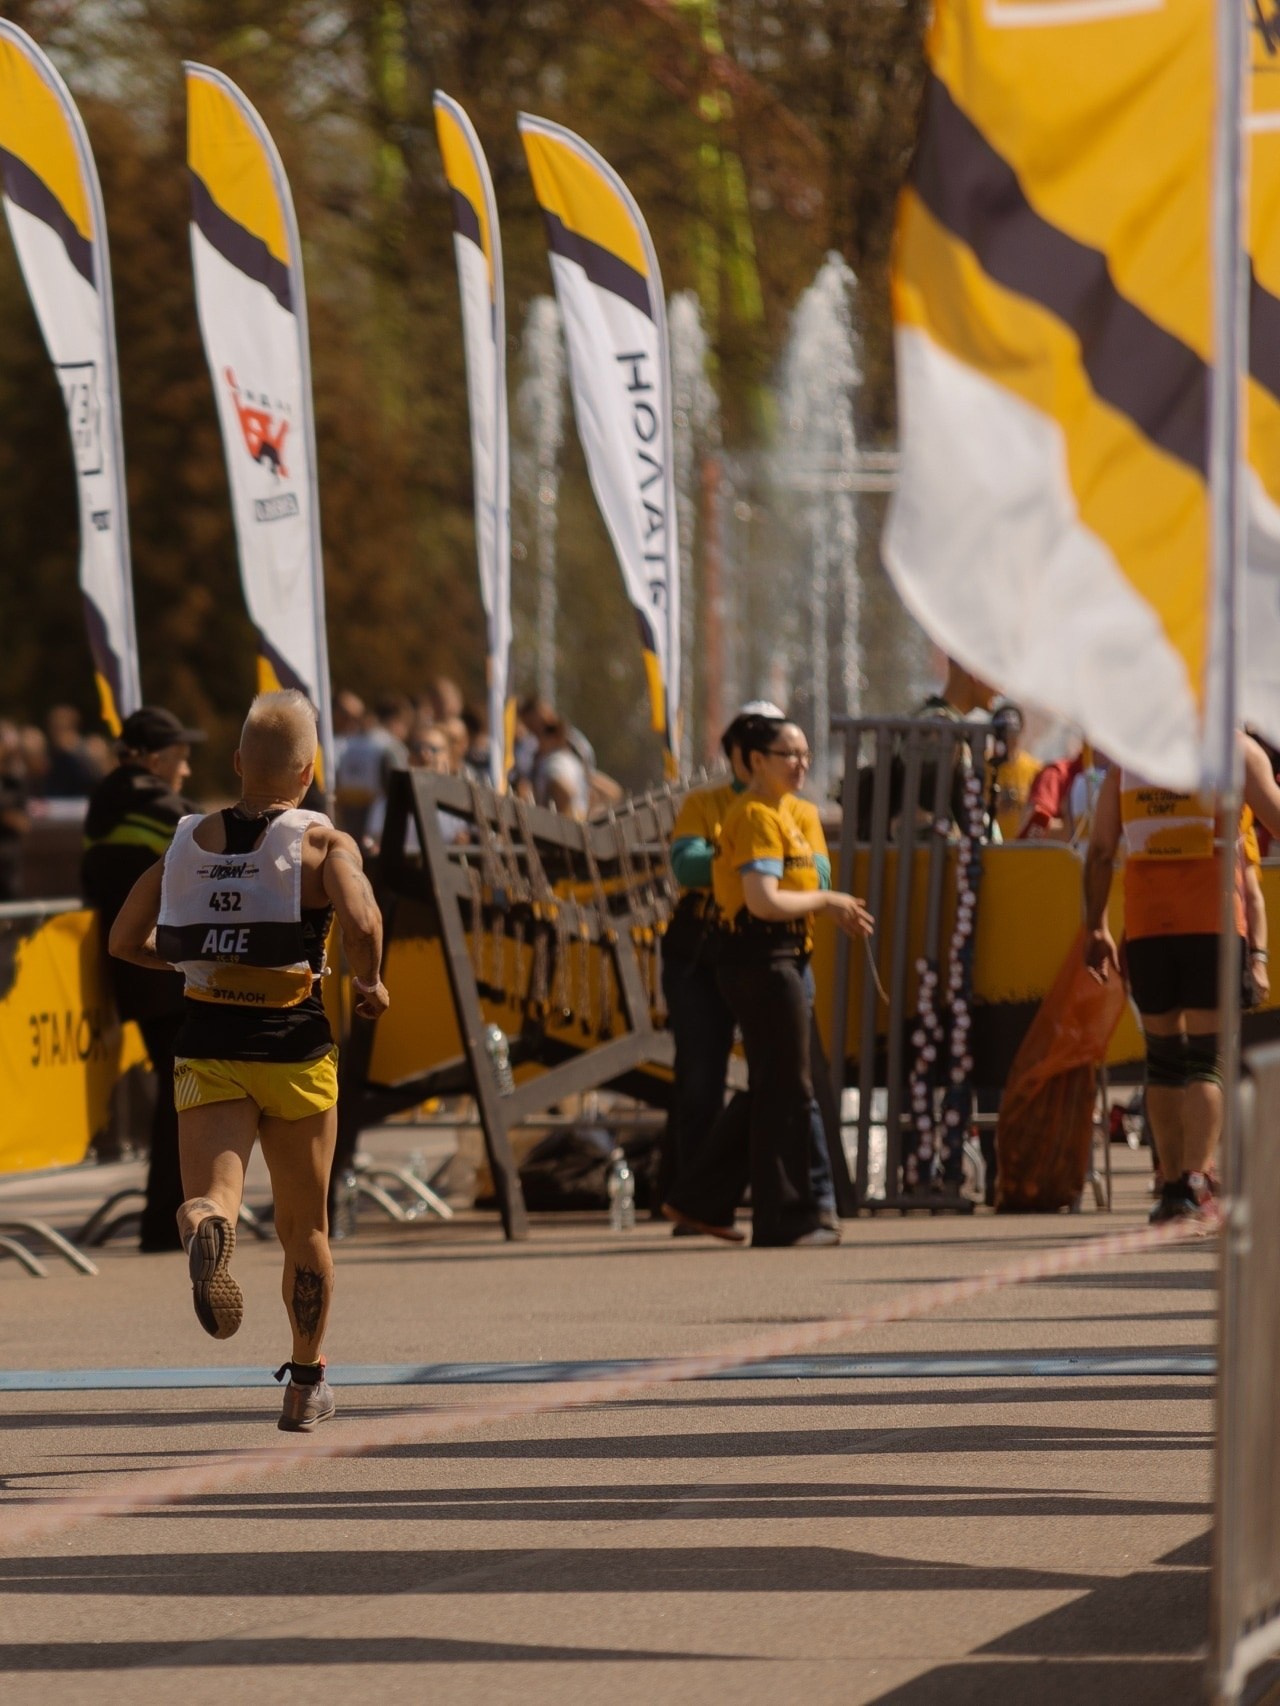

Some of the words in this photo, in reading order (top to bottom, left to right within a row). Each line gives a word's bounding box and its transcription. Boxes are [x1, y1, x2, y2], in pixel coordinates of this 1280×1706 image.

[210, 862, 247, 880] URBAN
[209, 892, 242, 912] 432
[201, 928, 250, 954] AGE
[212, 989, 266, 1004] ЭТАЛОН
